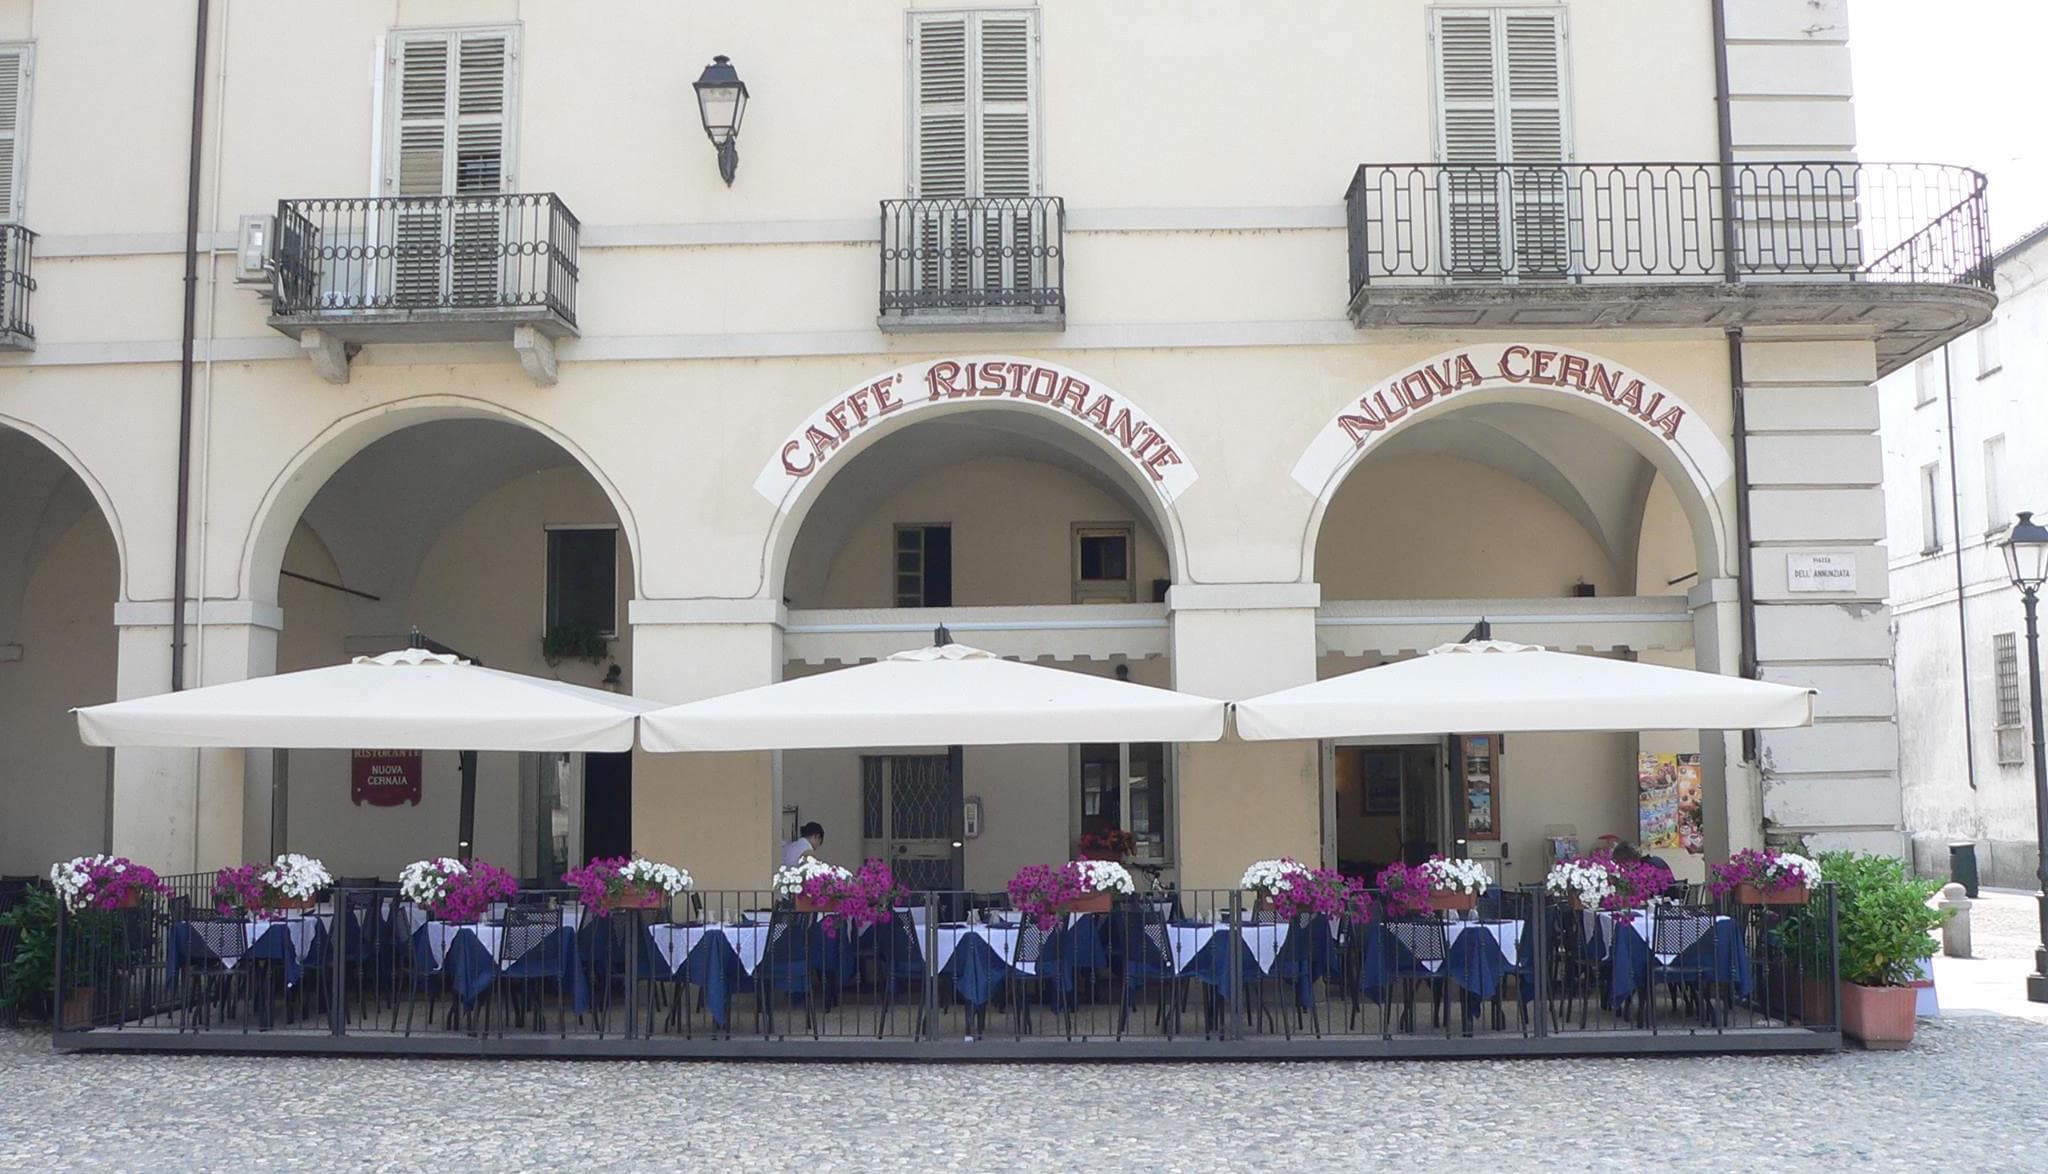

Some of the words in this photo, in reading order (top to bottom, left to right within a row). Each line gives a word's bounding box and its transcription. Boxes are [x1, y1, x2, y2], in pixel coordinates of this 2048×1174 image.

[1338, 354, 1482, 449] NUOVA
[1497, 345, 1688, 440] CERNAIA
[925, 361, 1181, 482] RISTORANTE
[1814, 569, 1850, 577] ANNUNZIATA
[372, 765, 403, 775] NUOVA
[367, 776, 408, 785] CERNAIA
